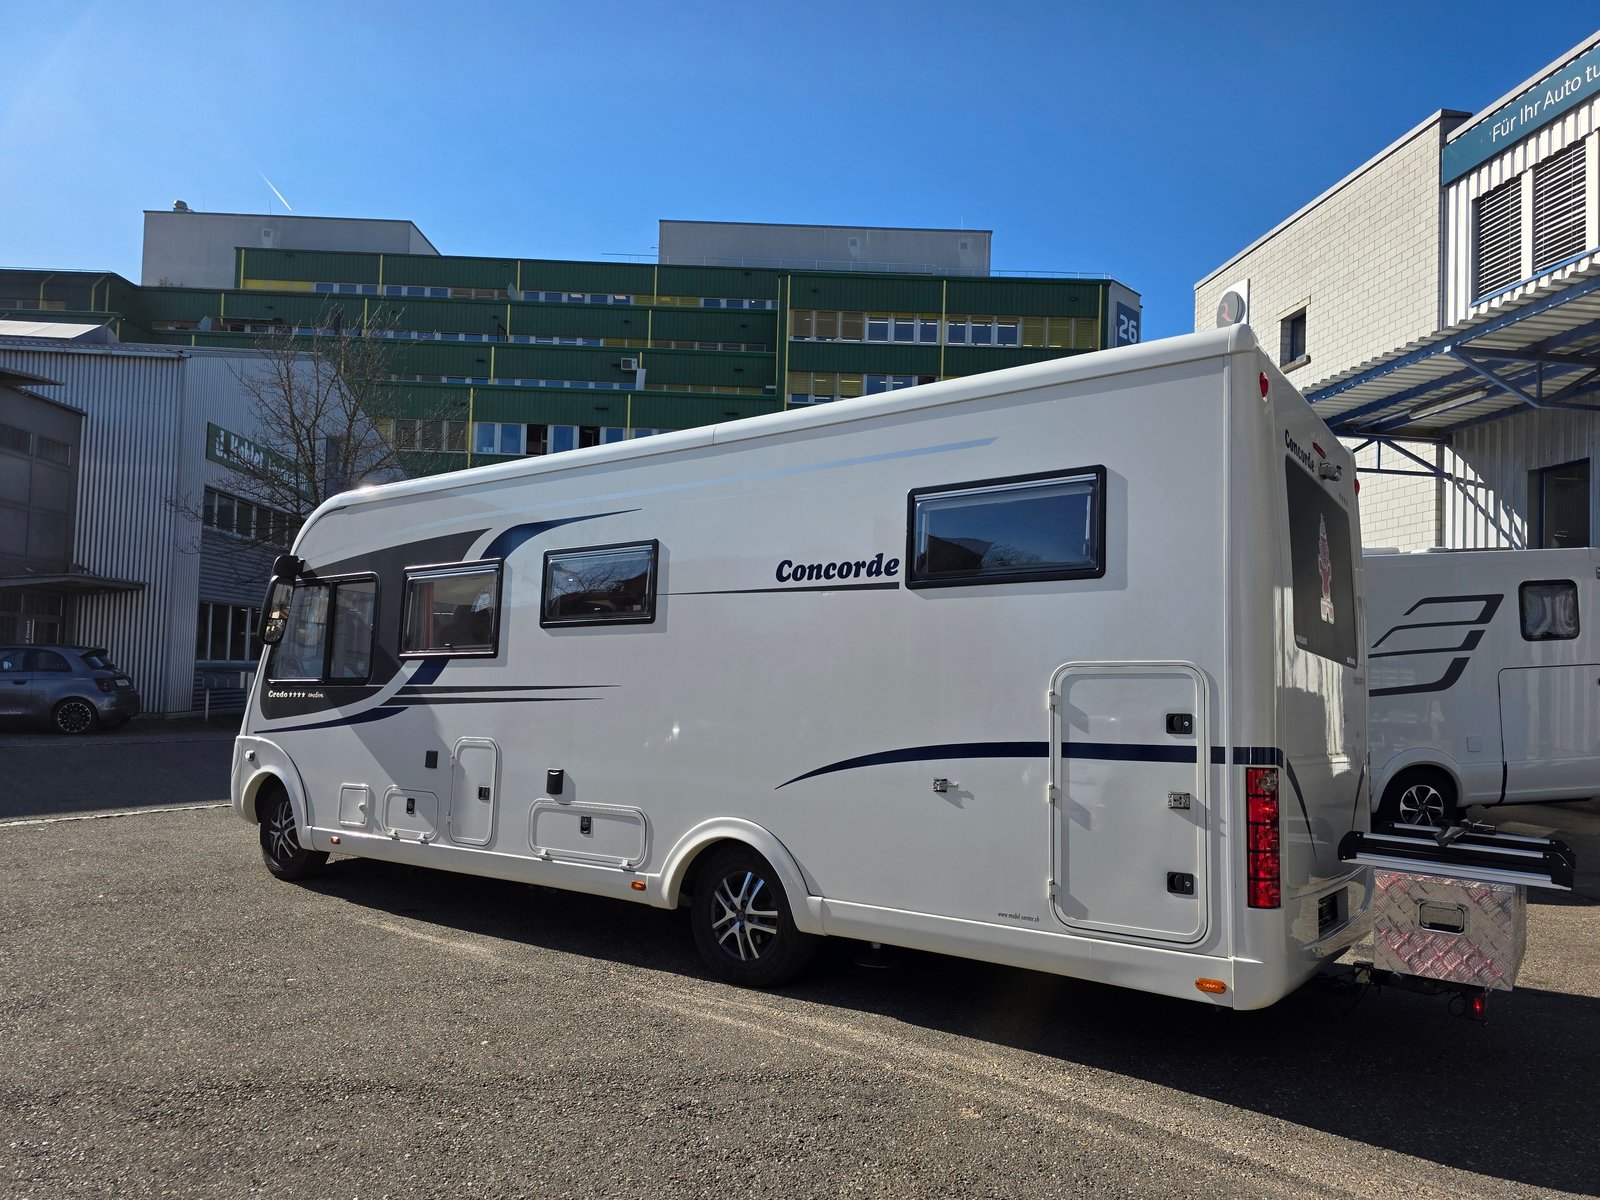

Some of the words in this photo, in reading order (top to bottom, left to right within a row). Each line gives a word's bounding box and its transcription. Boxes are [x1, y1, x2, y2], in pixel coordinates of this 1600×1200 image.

[1492, 115, 1517, 142] Für
[1520, 100, 1541, 125] Ihr
[1543, 76, 1581, 111] Auto
[1119, 313, 1138, 343] 26
[1284, 428, 1315, 473] Concorde
[775, 552, 900, 582] Concorde
[268, 690, 288, 698] Credo
